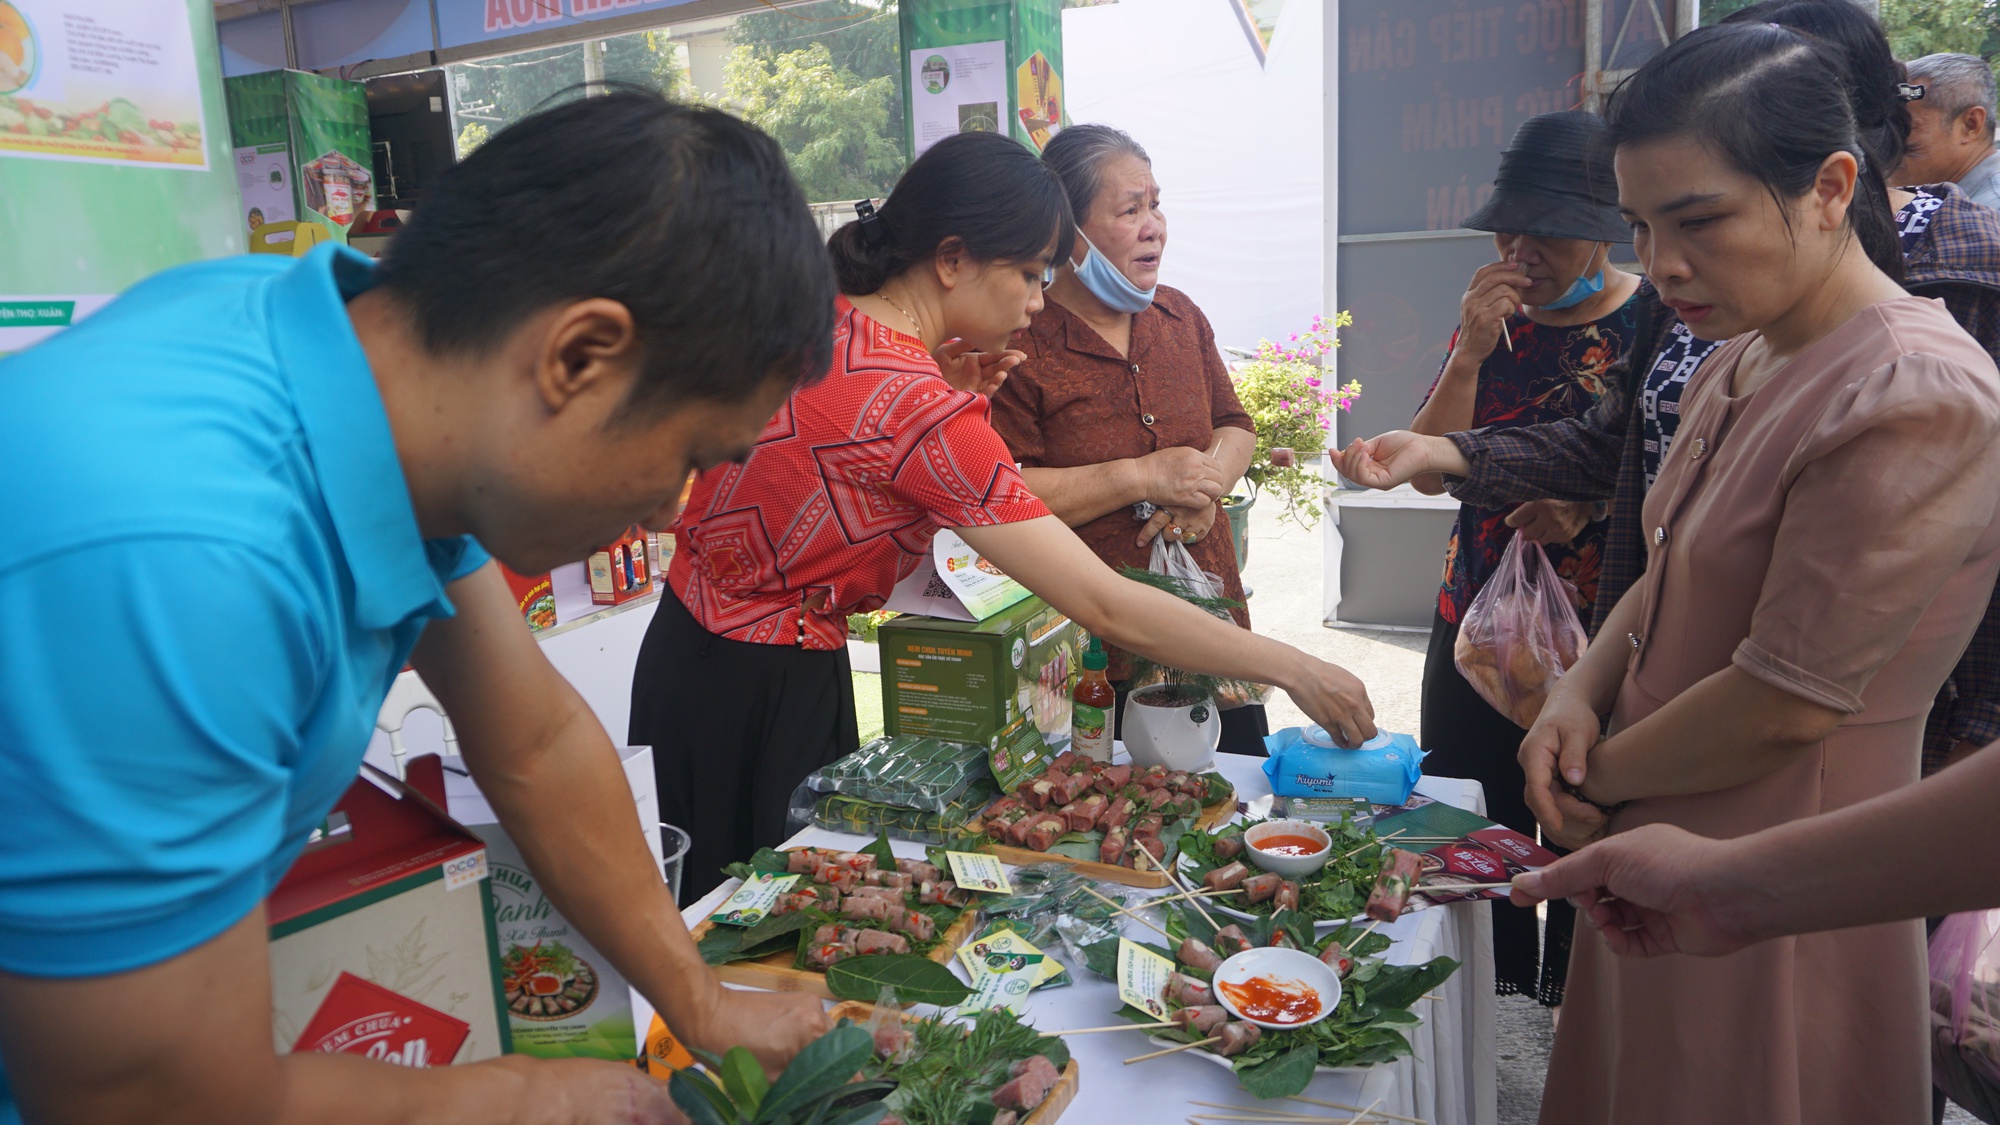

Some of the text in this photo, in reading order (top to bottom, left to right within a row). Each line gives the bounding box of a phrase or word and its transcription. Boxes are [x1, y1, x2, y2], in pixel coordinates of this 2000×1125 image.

[1296, 774, 1334, 787] Kiyomi
[446, 854, 485, 875] OCOP
[354, 1016, 401, 1036] CHUA
